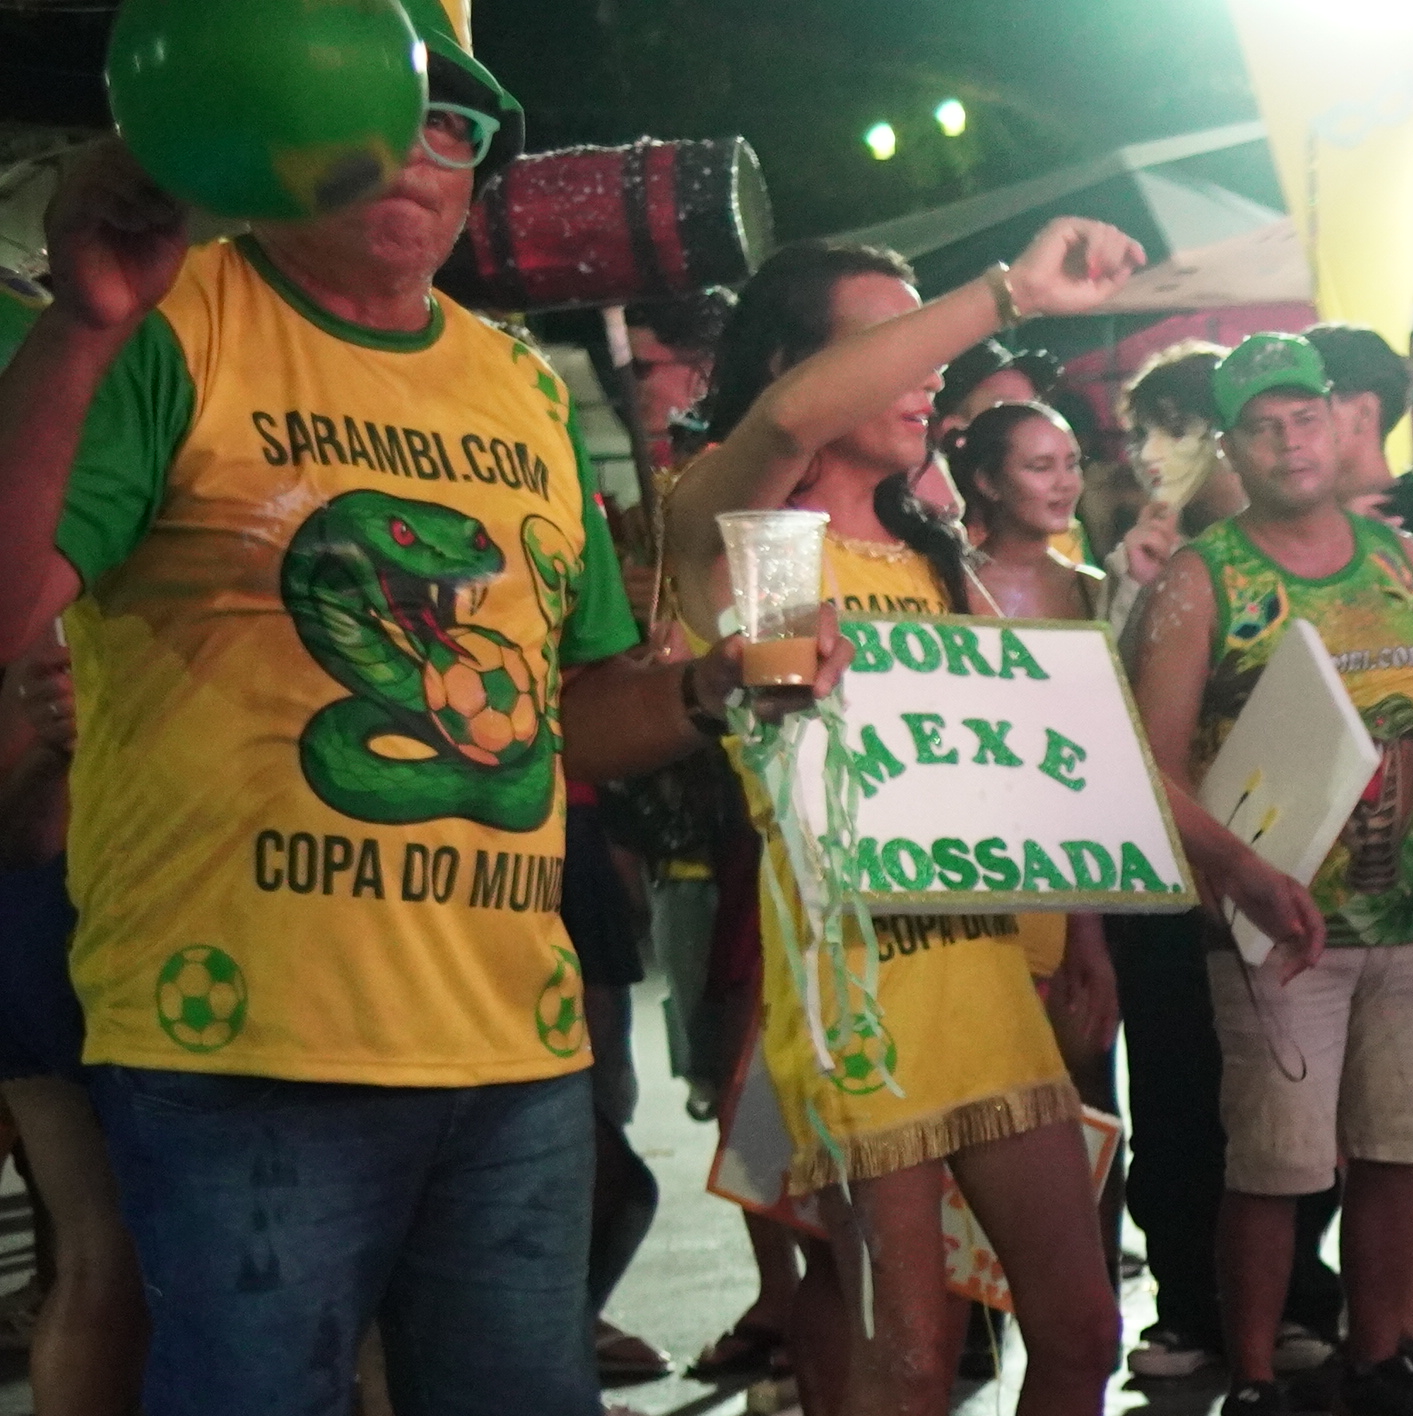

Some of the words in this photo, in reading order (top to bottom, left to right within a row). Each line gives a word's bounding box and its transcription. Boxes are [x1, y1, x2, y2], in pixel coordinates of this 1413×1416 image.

[251, 409, 550, 502] SARAMBI.COM
[840, 621, 1050, 680] BORA
[851, 712, 1087, 799] MEXE
[255, 829, 386, 900] COPA
[401, 843, 460, 903] DO
